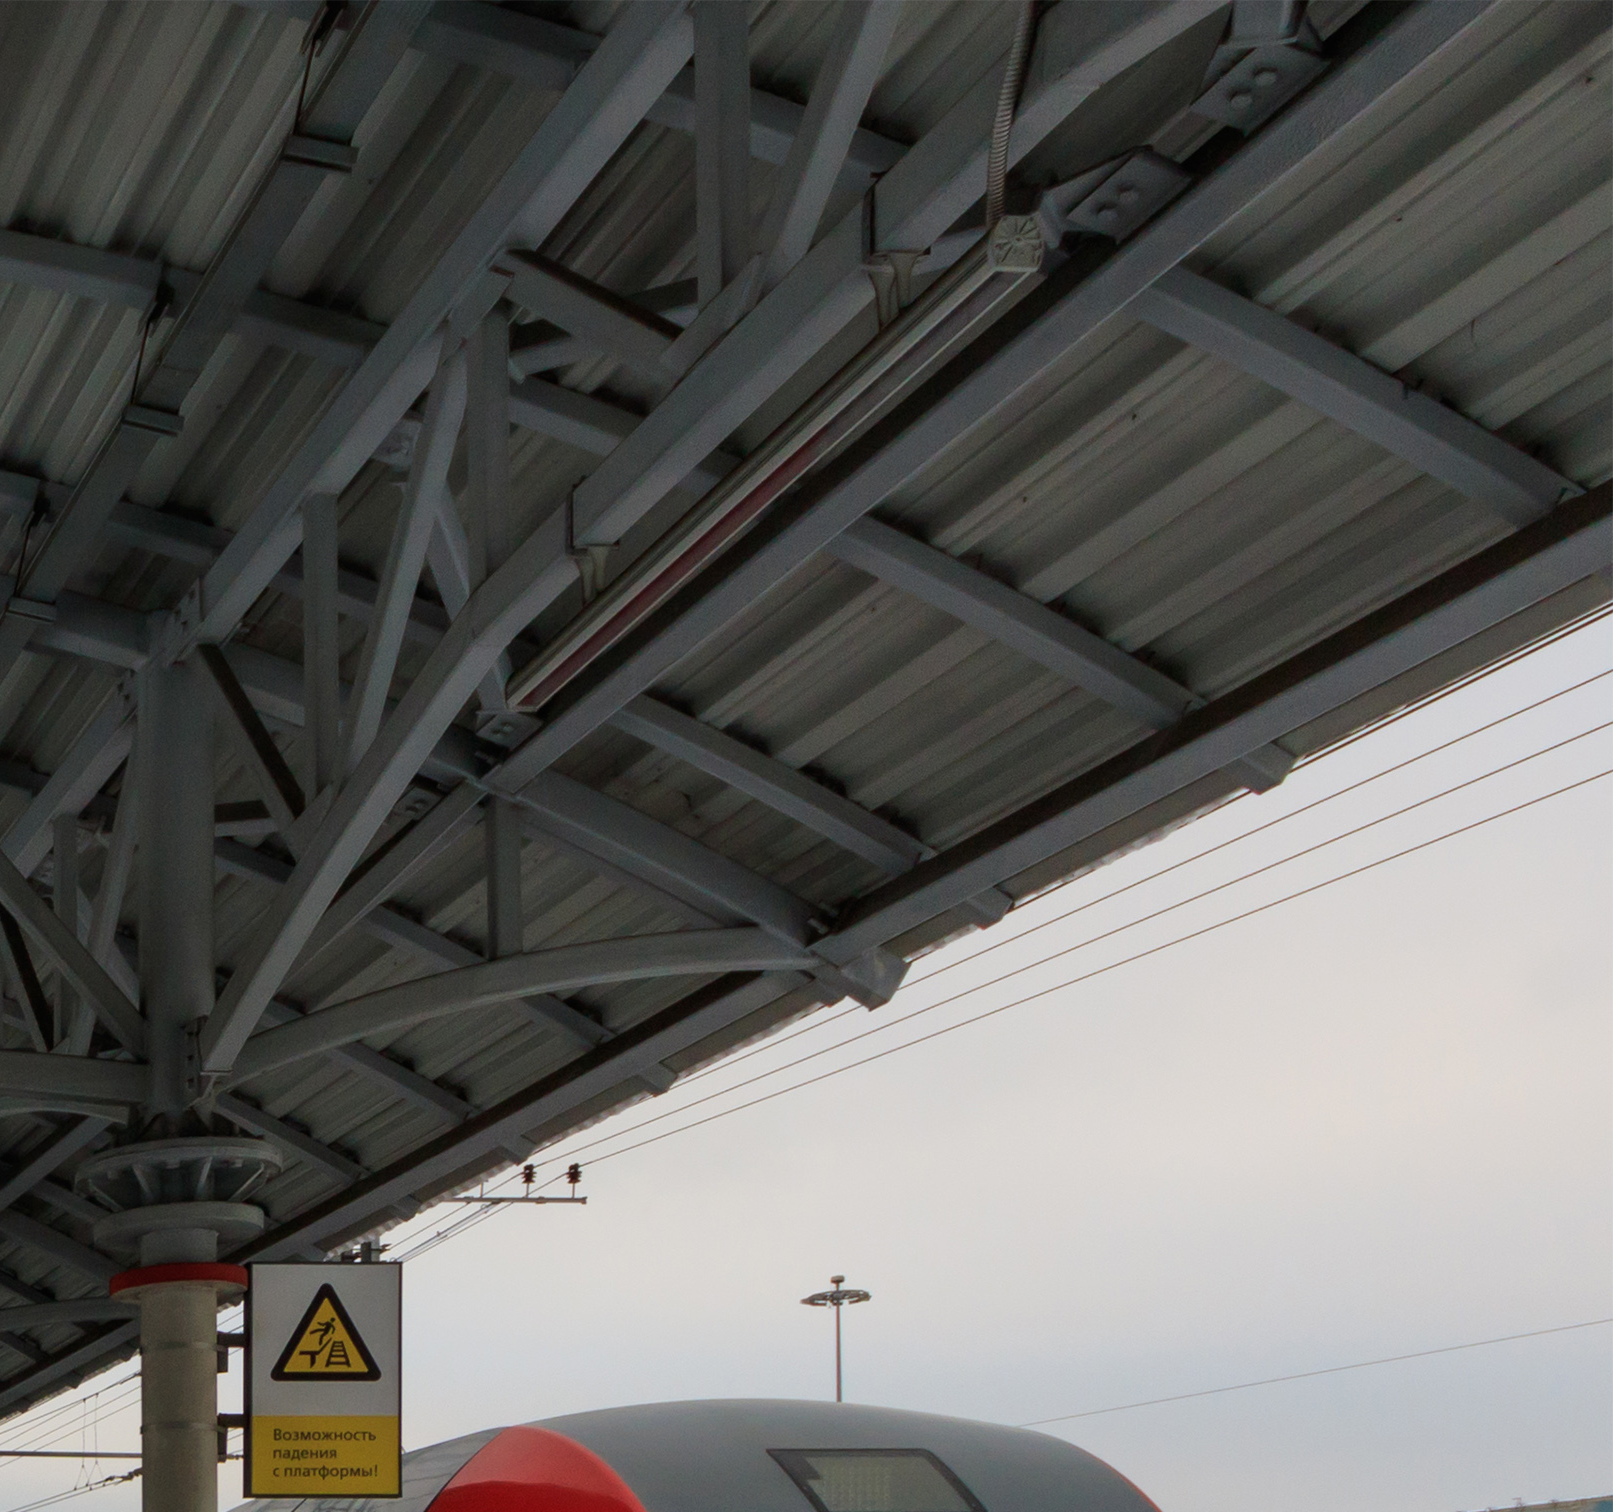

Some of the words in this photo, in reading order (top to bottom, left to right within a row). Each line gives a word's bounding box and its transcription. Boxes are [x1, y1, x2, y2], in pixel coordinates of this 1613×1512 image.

[273, 1428, 377, 1441] Возможность
[273, 1449, 337, 1460] падения
[273, 1467, 280, 1477] с
[284, 1465, 379, 1480] платформы!
